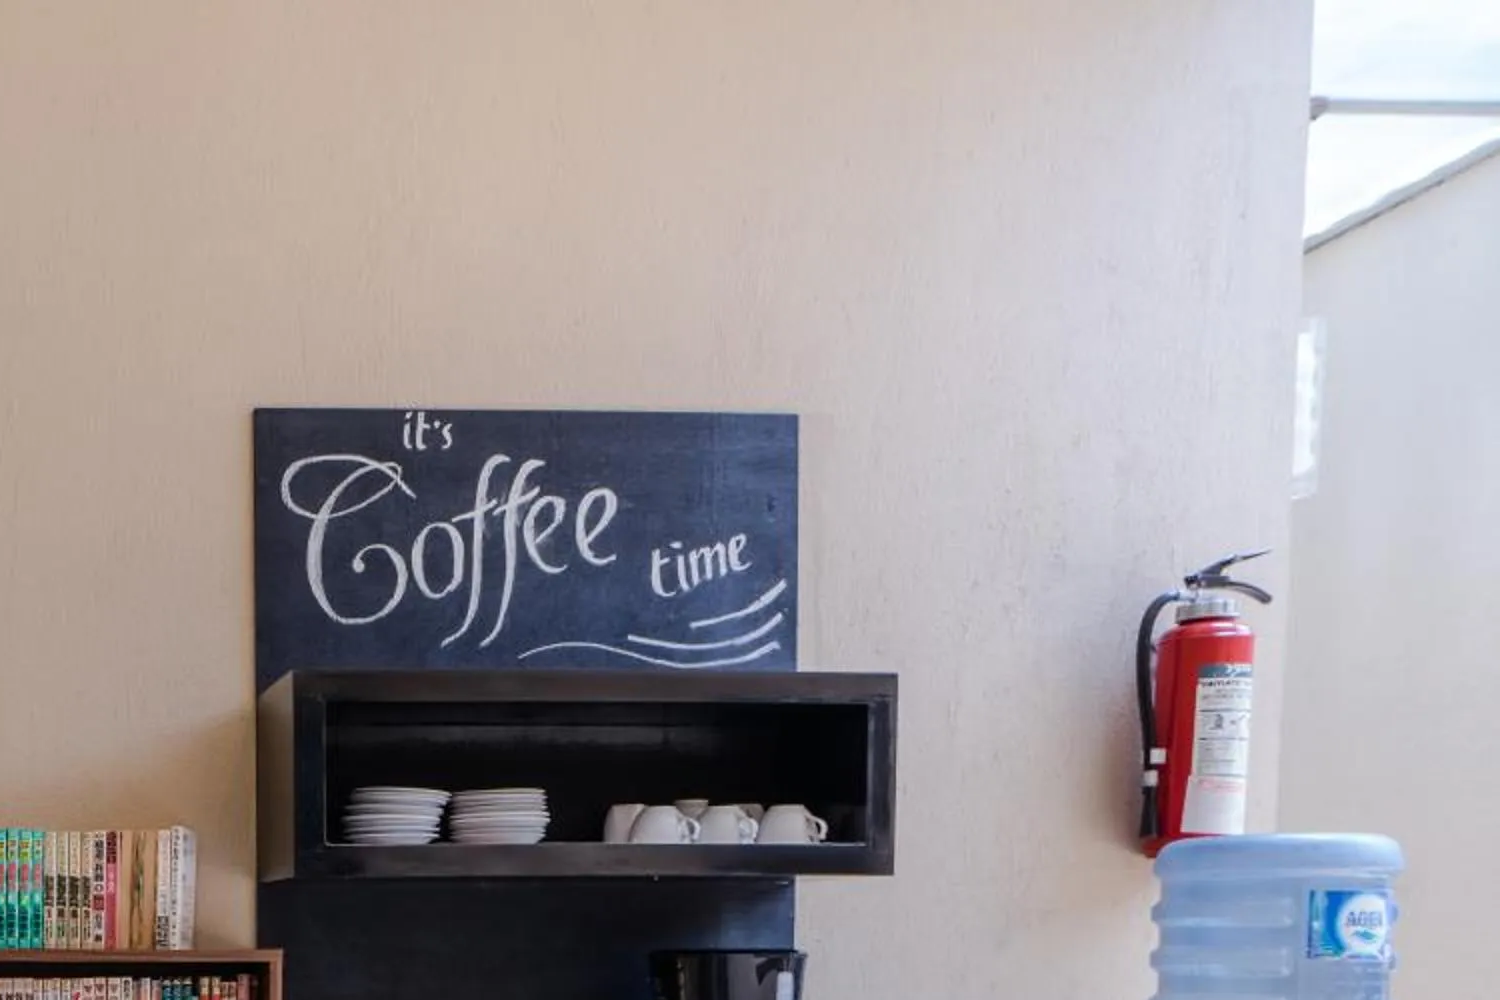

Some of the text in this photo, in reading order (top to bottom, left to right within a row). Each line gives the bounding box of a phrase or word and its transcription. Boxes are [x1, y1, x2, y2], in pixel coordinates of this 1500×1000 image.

[403, 412, 453, 450] it's
[281, 453, 618, 648] Coffee
[651, 533, 753, 598] time
